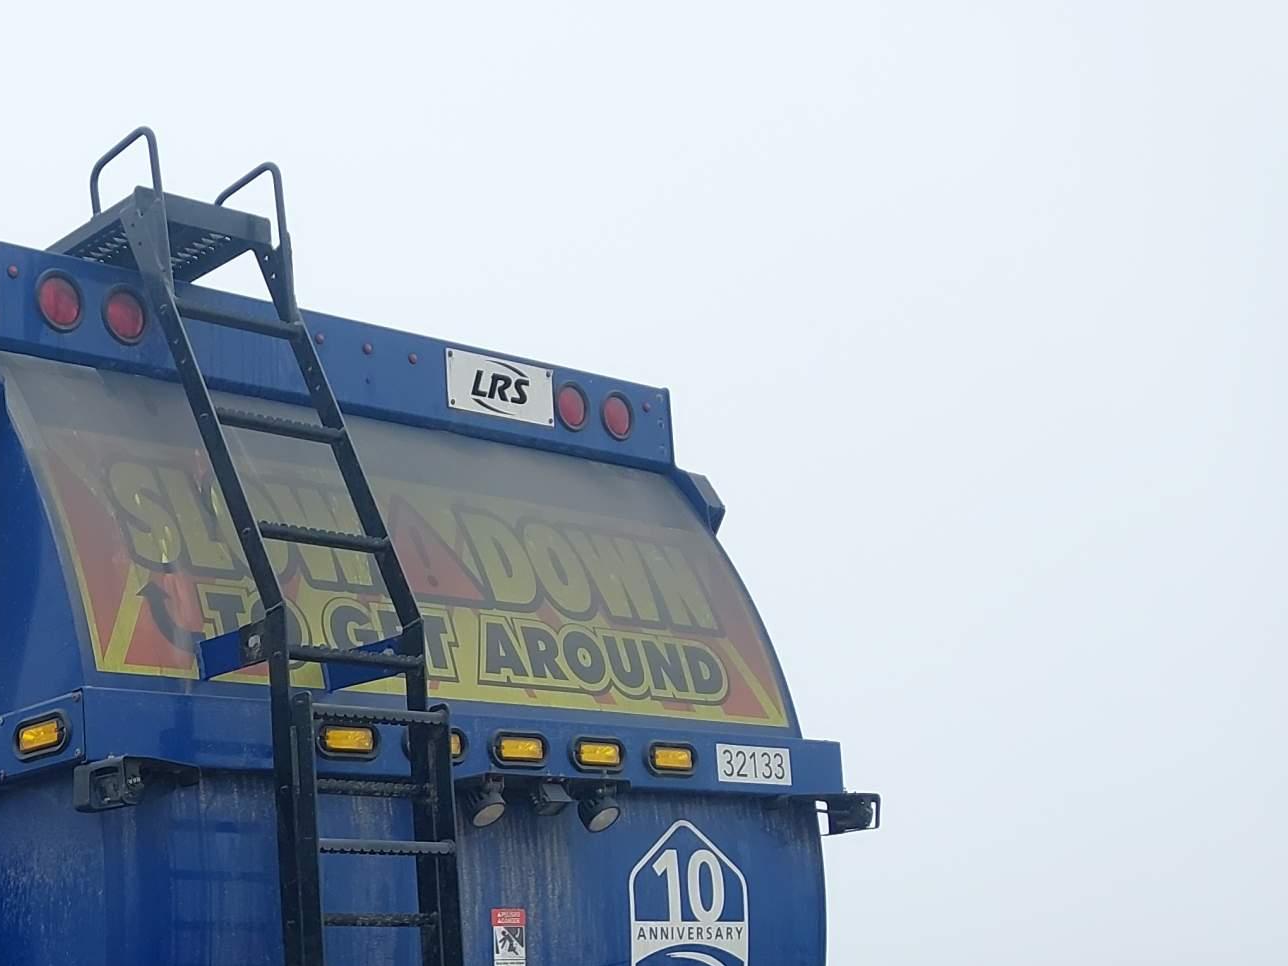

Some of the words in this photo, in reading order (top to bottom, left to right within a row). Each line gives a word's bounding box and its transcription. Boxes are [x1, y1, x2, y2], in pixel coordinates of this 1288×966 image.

[471, 369, 530, 405] LRS
[457, 508, 720, 633] DOWN
[485, 621, 724, 695] AROUND
[722, 749, 785, 780] 32133
[652, 849, 725, 922] 10
[637, 926, 744, 940] ANNIVERSARY
